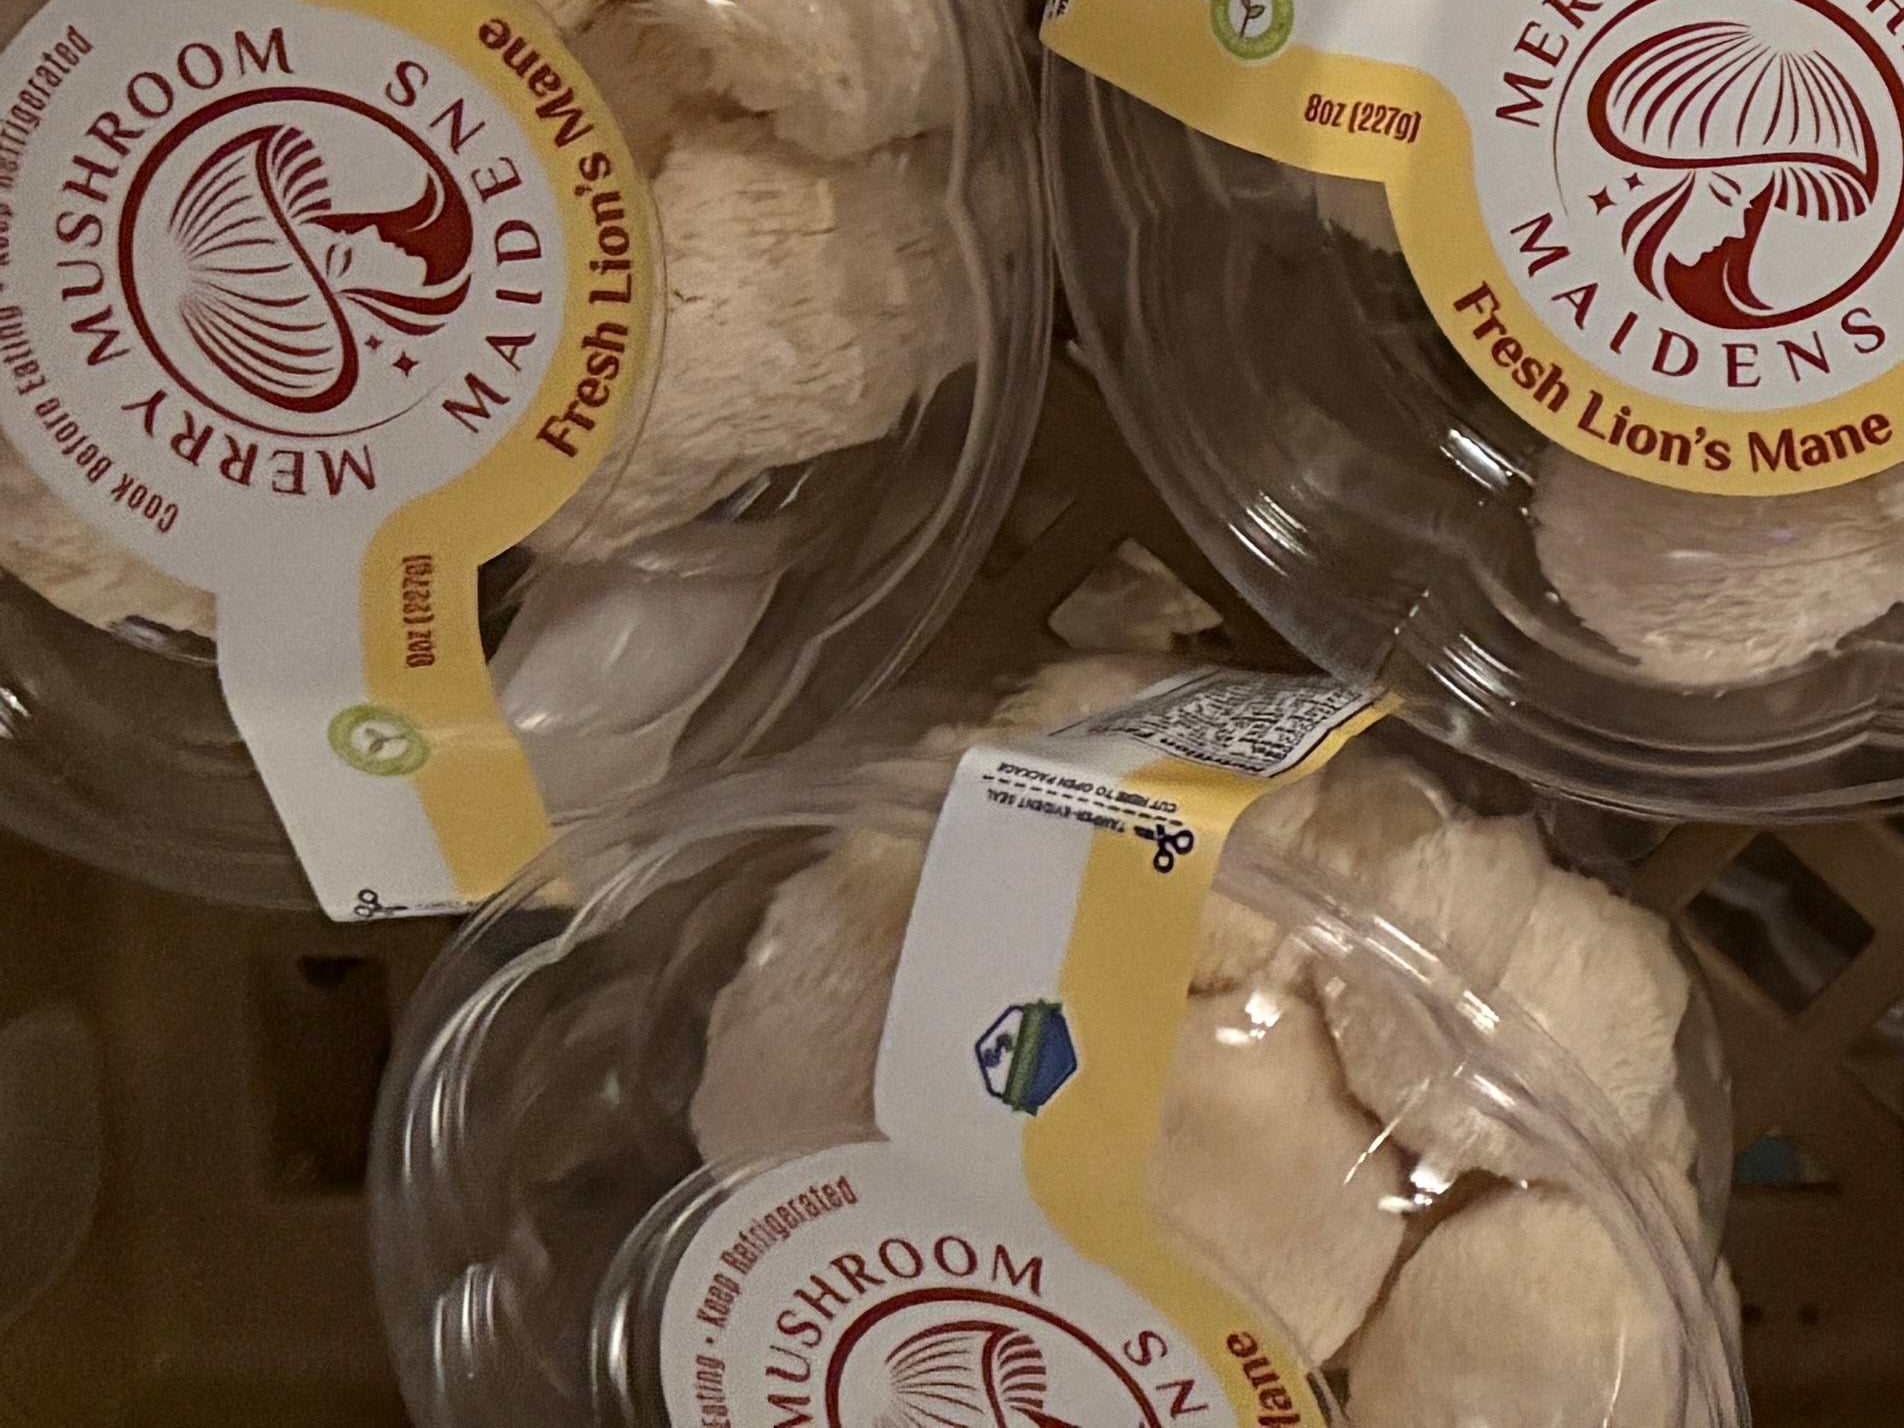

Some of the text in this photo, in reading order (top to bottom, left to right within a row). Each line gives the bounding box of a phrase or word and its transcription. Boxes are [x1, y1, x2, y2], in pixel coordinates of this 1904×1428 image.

[387, 60, 542, 427] MAIDENS
[476, 17, 633, 456] Fresh Lion's Mane
[1304, 93, 1421, 145] 8oz (227g)
[56, 26, 375, 496] MERRY MUSHROOM
[1454, 282, 1893, 472] Fresh Lion's Mane
[1515, 214, 1885, 387] MAIDENS
